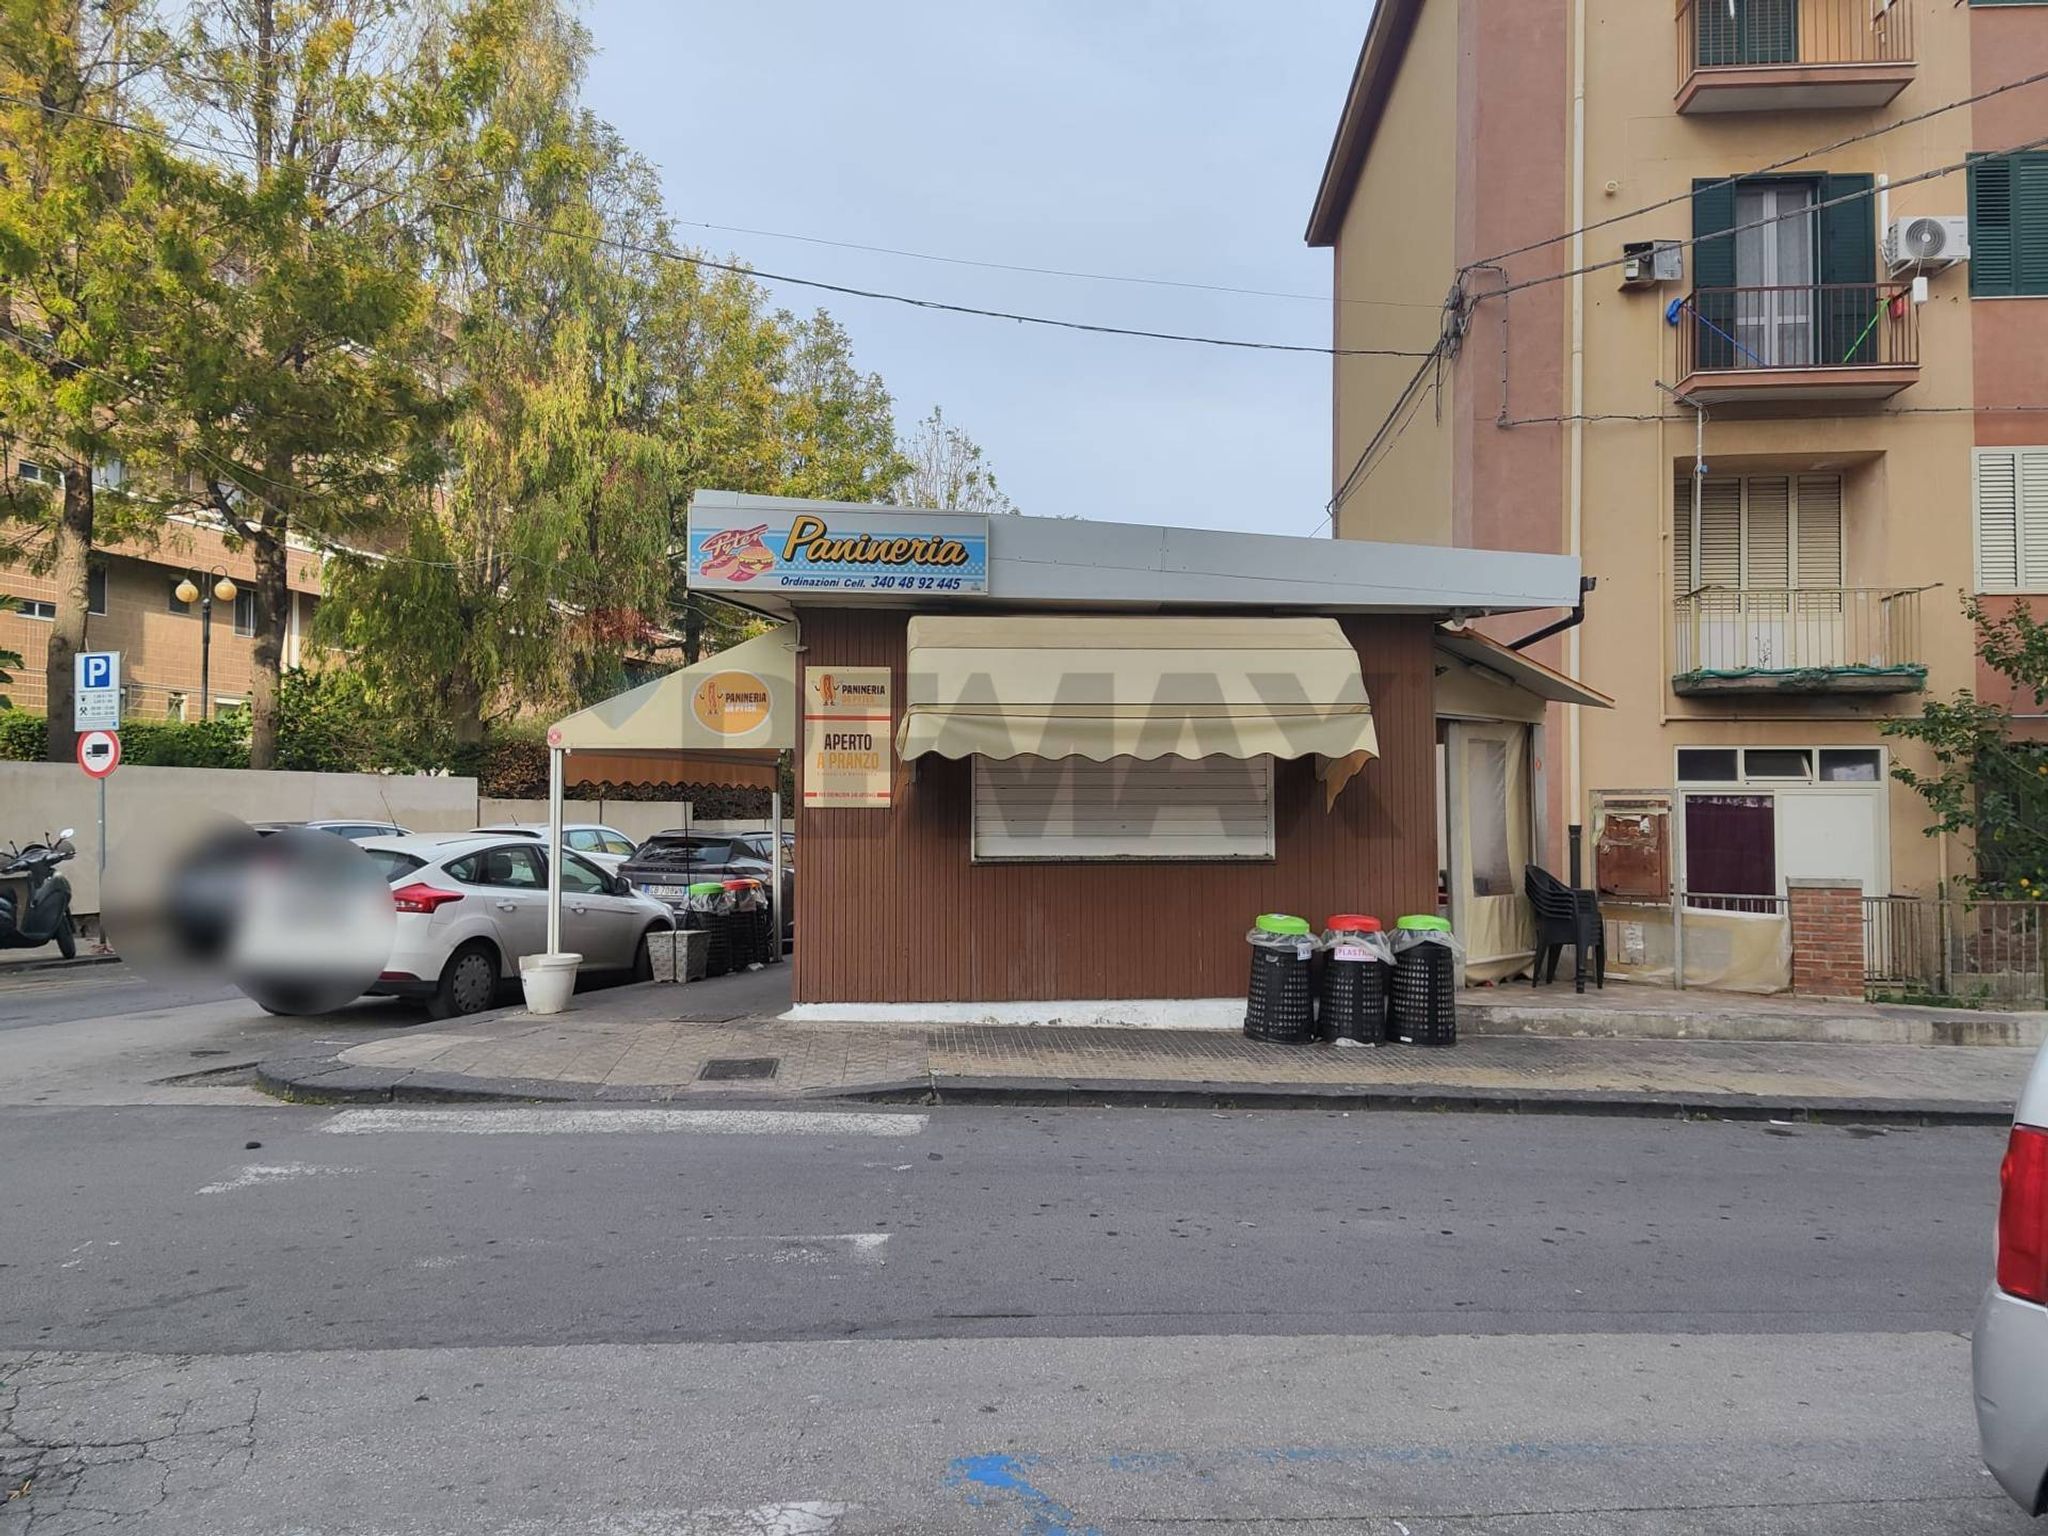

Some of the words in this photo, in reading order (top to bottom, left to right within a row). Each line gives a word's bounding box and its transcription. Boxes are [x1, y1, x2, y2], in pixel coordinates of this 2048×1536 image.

[782, 514, 970, 566] Panineria
[780, 576, 840, 588] Ordinazioni
[844, 577, 866, 588] Cell.
[871, 575, 895, 588] 340
[898, 576, 914, 589] 48
[916, 577, 933, 589] 92
[937, 577, 962, 590] 445
[89, 658, 107, 686] P
[725, 692, 767, 703] PANINERIA
[842, 684, 886, 695] PANINERIA
[824, 733, 872, 751] APERTO
[817, 753, 825, 768] A
[829, 753, 879, 769] PRANZO
